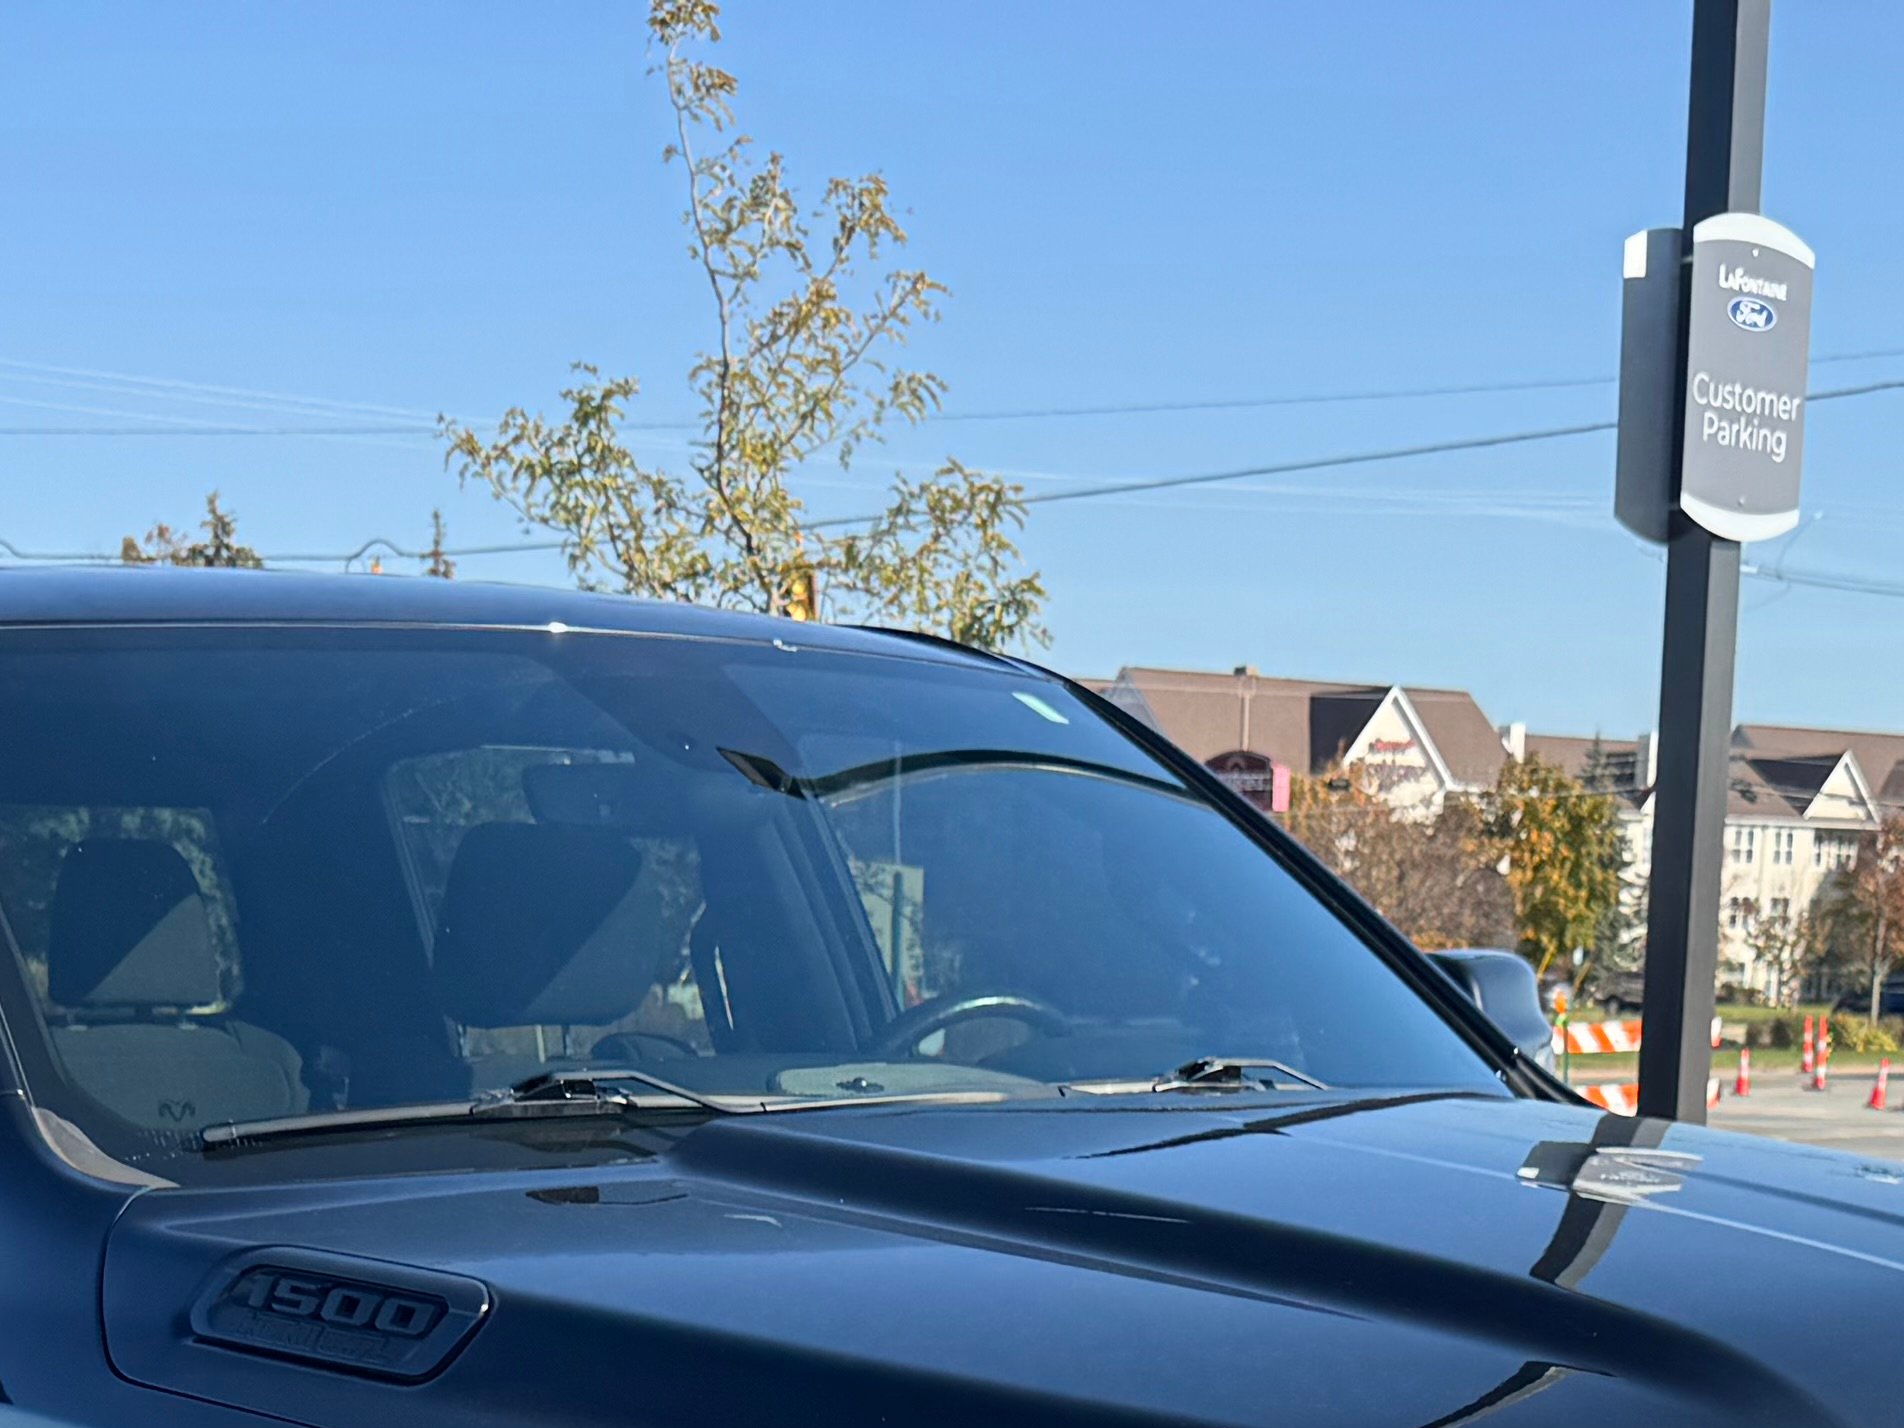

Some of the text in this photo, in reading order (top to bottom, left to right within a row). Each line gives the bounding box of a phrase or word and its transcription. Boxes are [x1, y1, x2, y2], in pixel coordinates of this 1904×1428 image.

[1693, 371, 1800, 421] Customer
[1702, 411, 1788, 463] Parking
[232, 1274, 440, 1337] 1500
